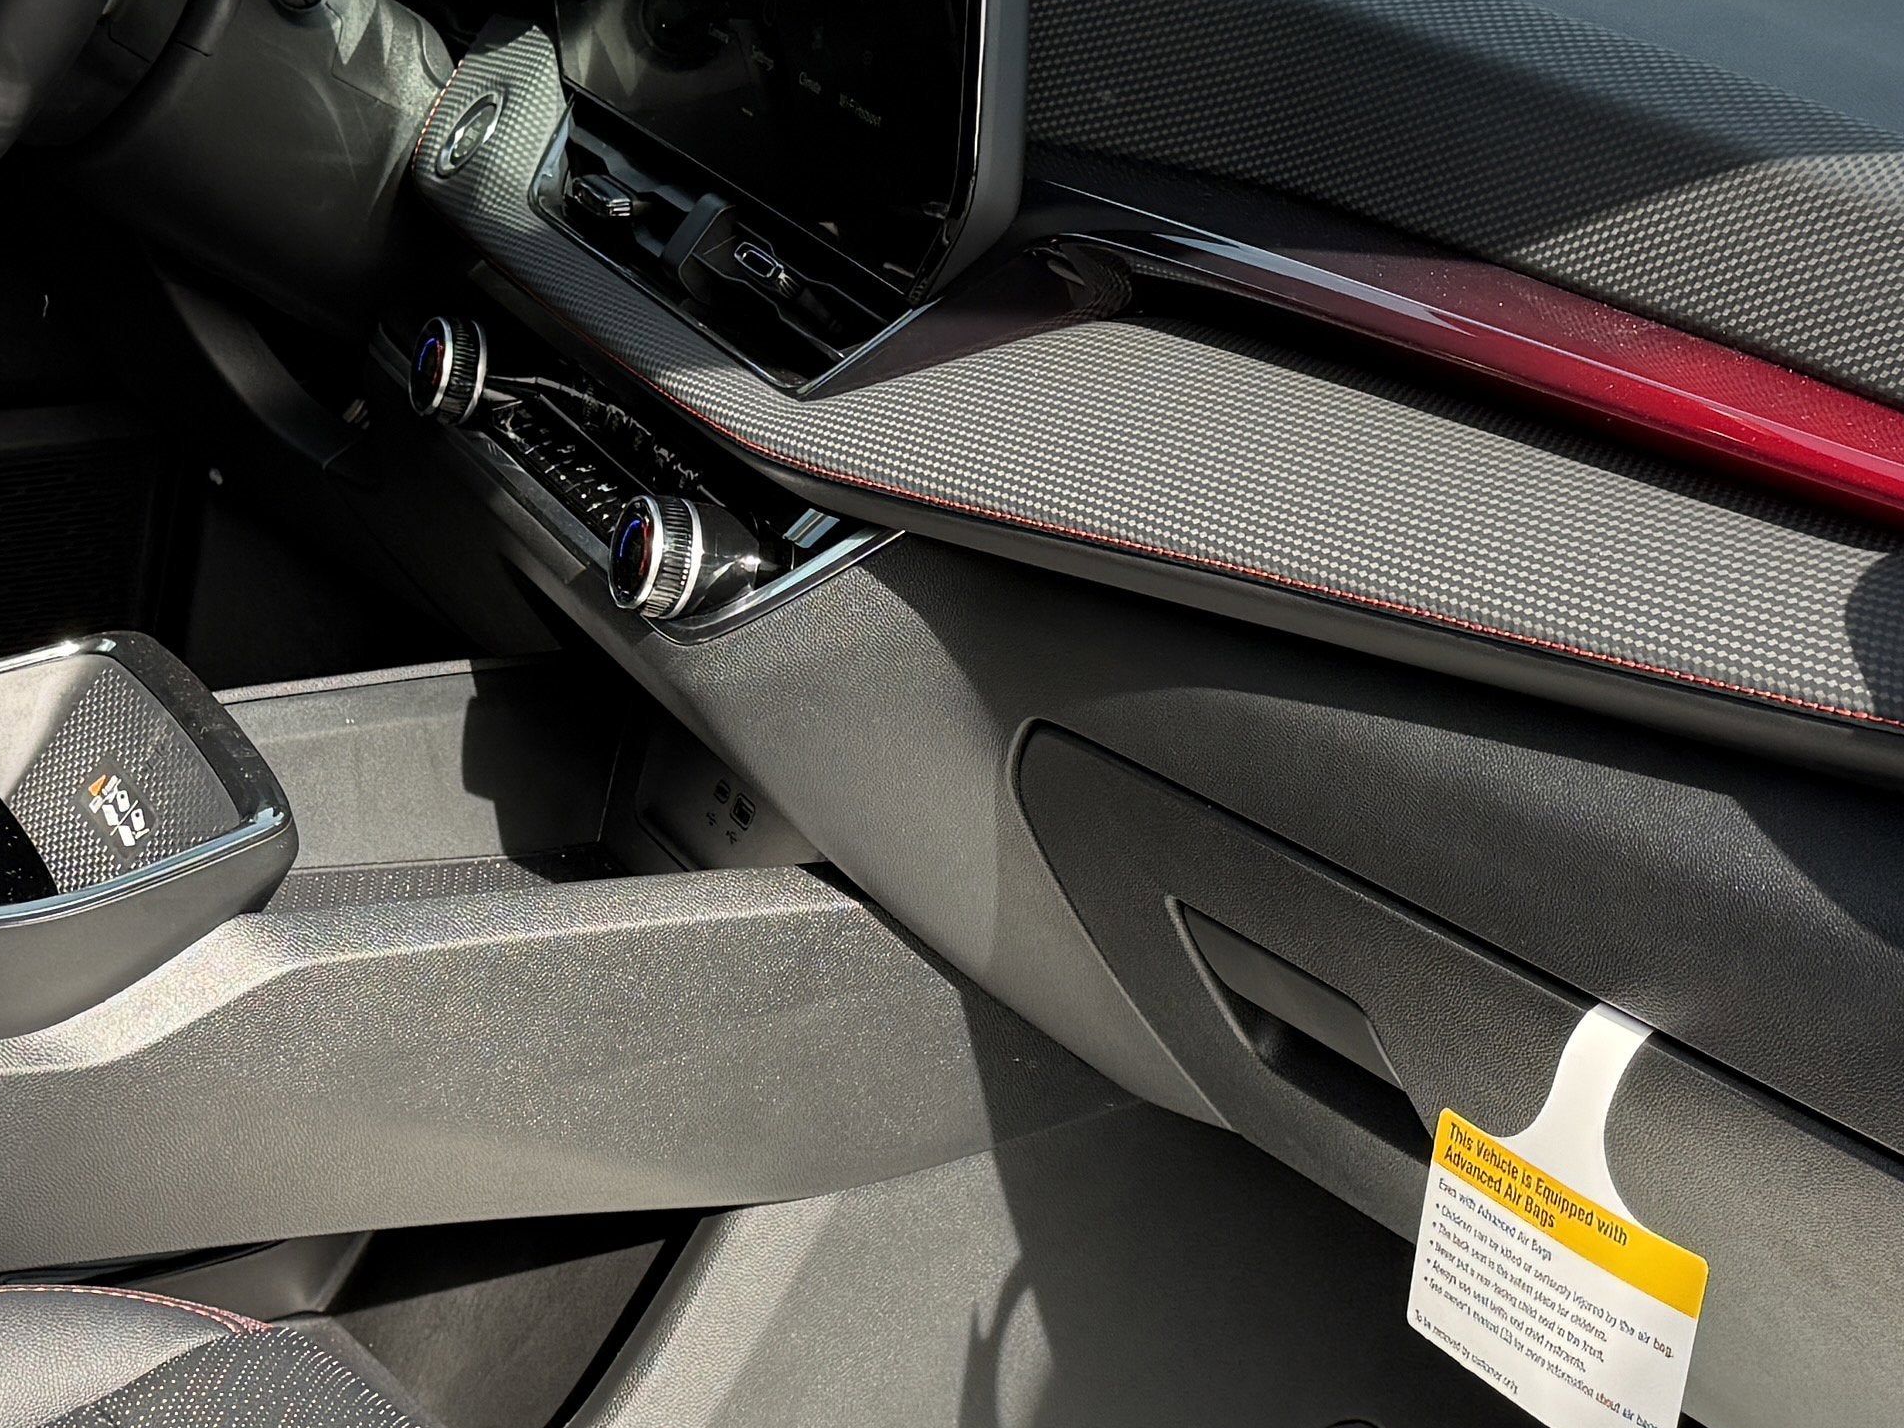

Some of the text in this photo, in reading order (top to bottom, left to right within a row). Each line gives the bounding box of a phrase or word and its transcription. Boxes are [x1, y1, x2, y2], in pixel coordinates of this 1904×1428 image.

[1443, 1142, 1556, 1232] Advanced Air Bags
[1447, 1120, 1474, 1152] This
[1475, 1139, 1520, 1181] Vehicle
[1533, 1176, 1594, 1230] Equipped
[1595, 1213, 1629, 1248] with
